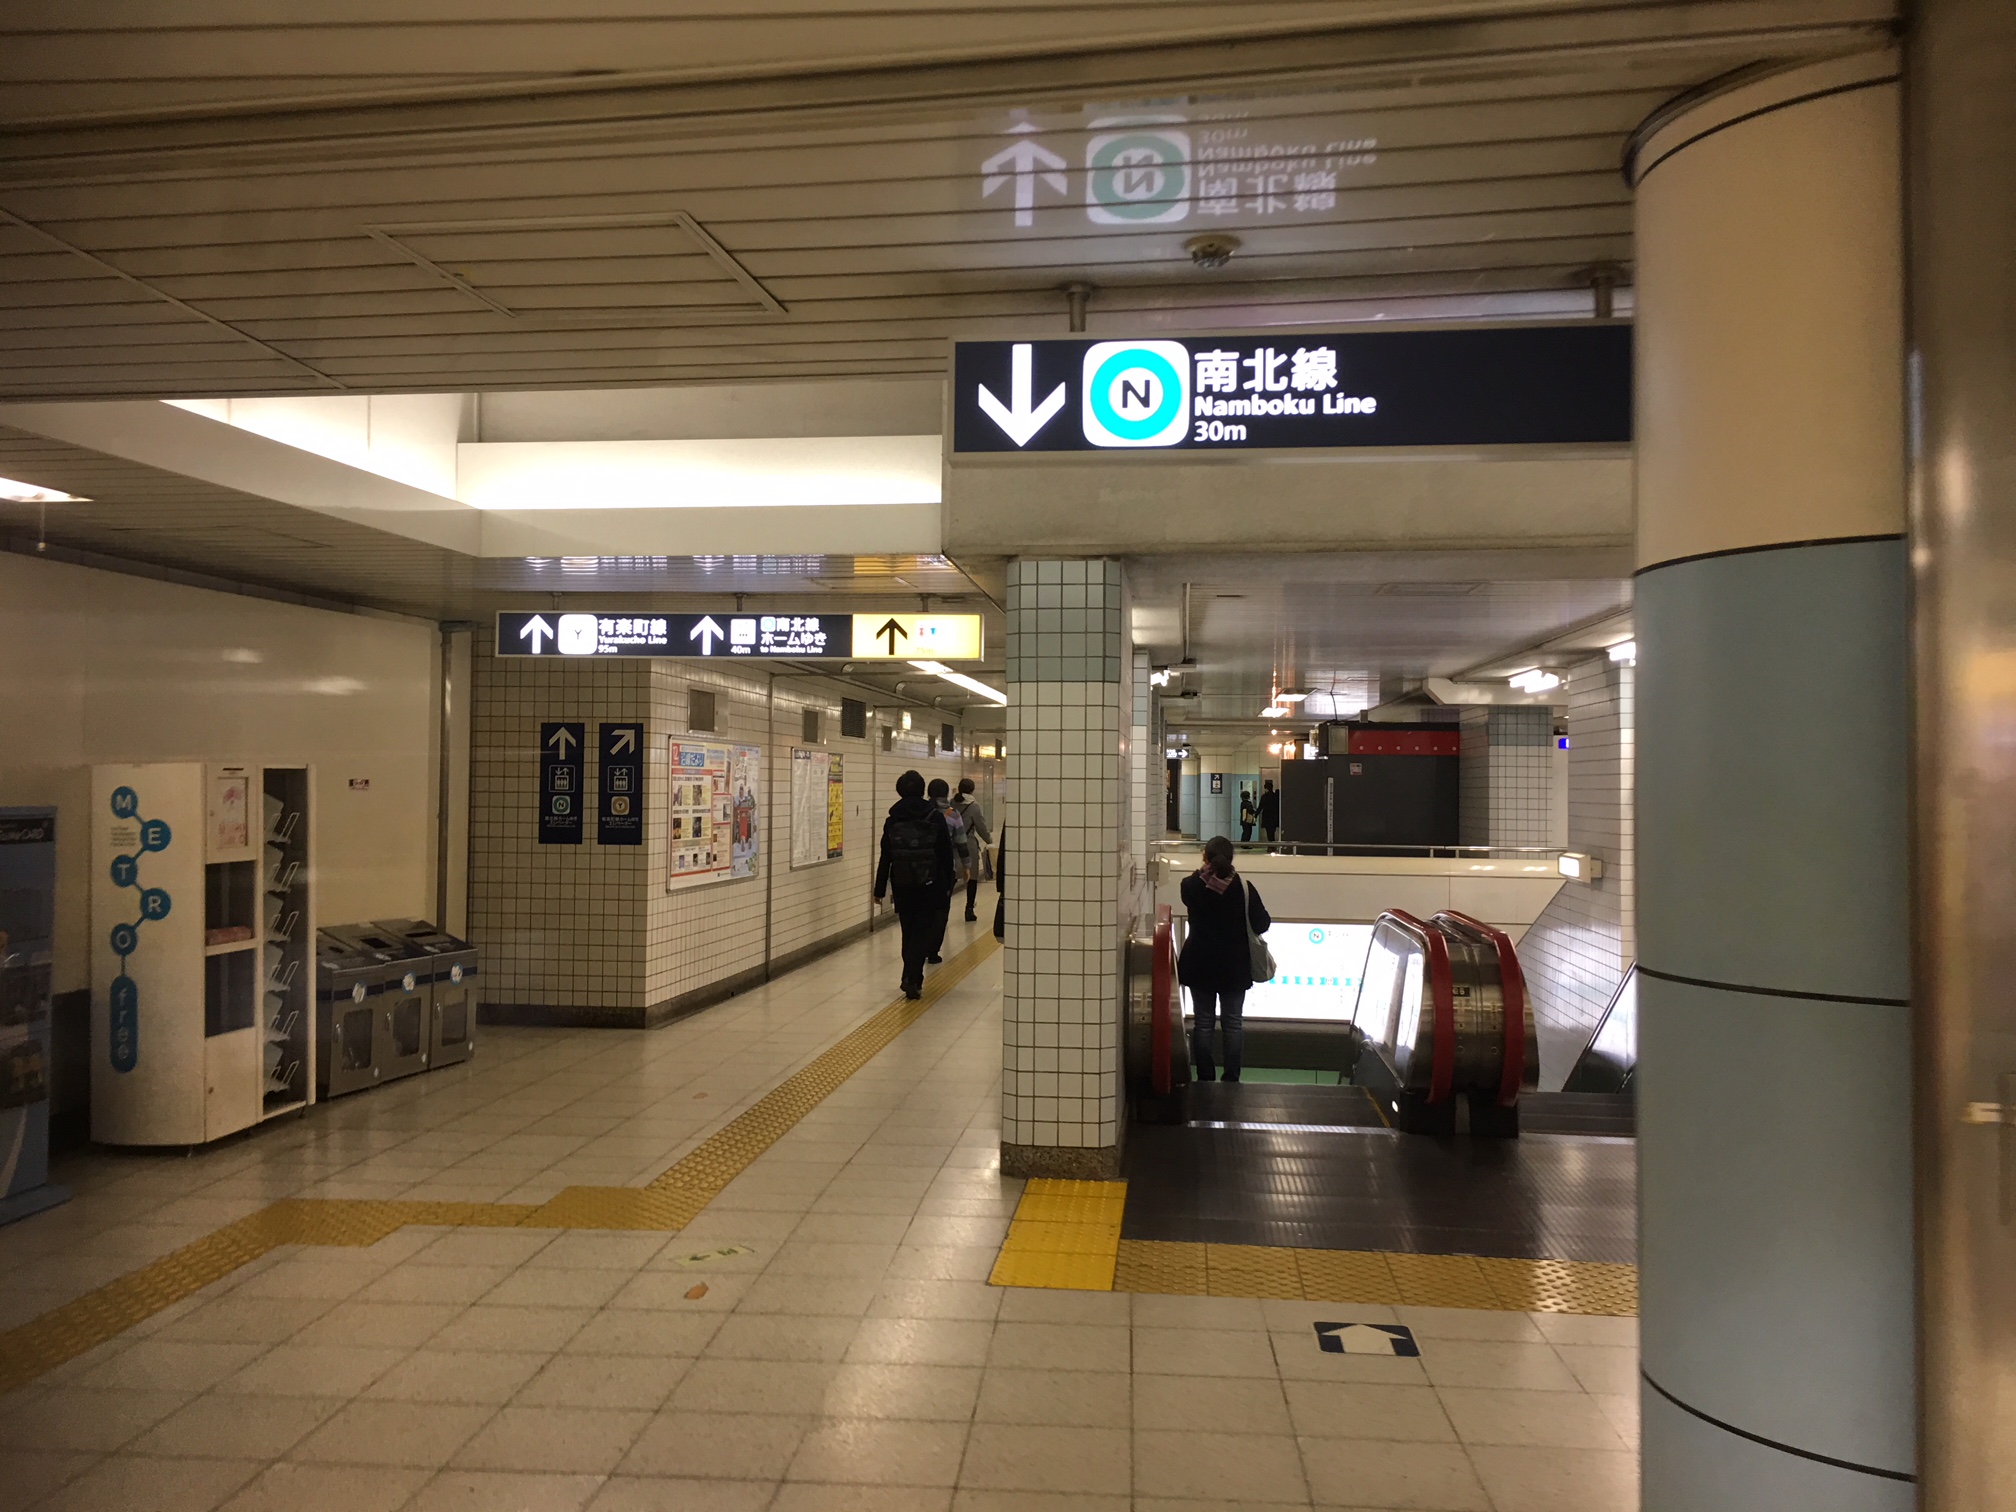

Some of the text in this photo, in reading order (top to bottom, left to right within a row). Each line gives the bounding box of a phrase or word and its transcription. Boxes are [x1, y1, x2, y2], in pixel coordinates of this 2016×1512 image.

[1194, 346, 1338, 393] 南北線
[1122, 379, 1150, 409] N
[1194, 392, 1377, 416] Namboku Line
[1194, 420, 1247, 442] 30m
[574, 629, 583, 640] Y
[761, 632, 828, 646] ホームゆき
[731, 645, 751, 654] 40m
